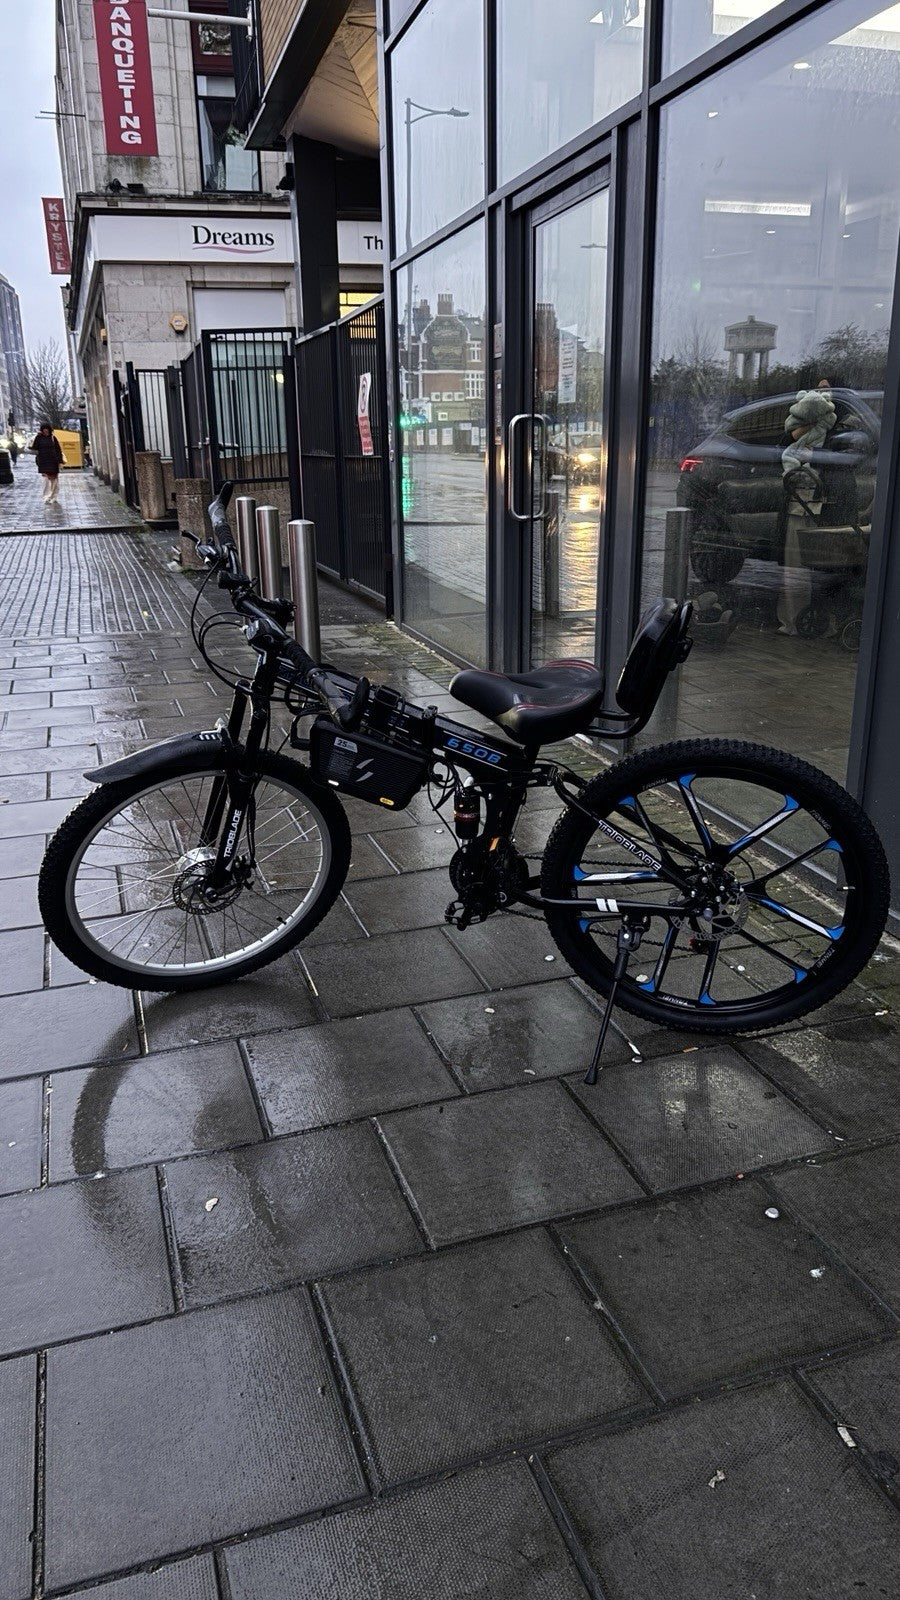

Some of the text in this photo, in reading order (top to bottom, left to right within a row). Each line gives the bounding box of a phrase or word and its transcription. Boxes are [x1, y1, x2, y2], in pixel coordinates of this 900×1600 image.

[109, 0, 142, 144] ANQUETING
[191, 225, 275, 246] Dreams
[447, 738, 501, 764] 650B
[223, 808, 242, 858] TRIOBLADE
[599, 819, 662, 871] TRIOBLADE
